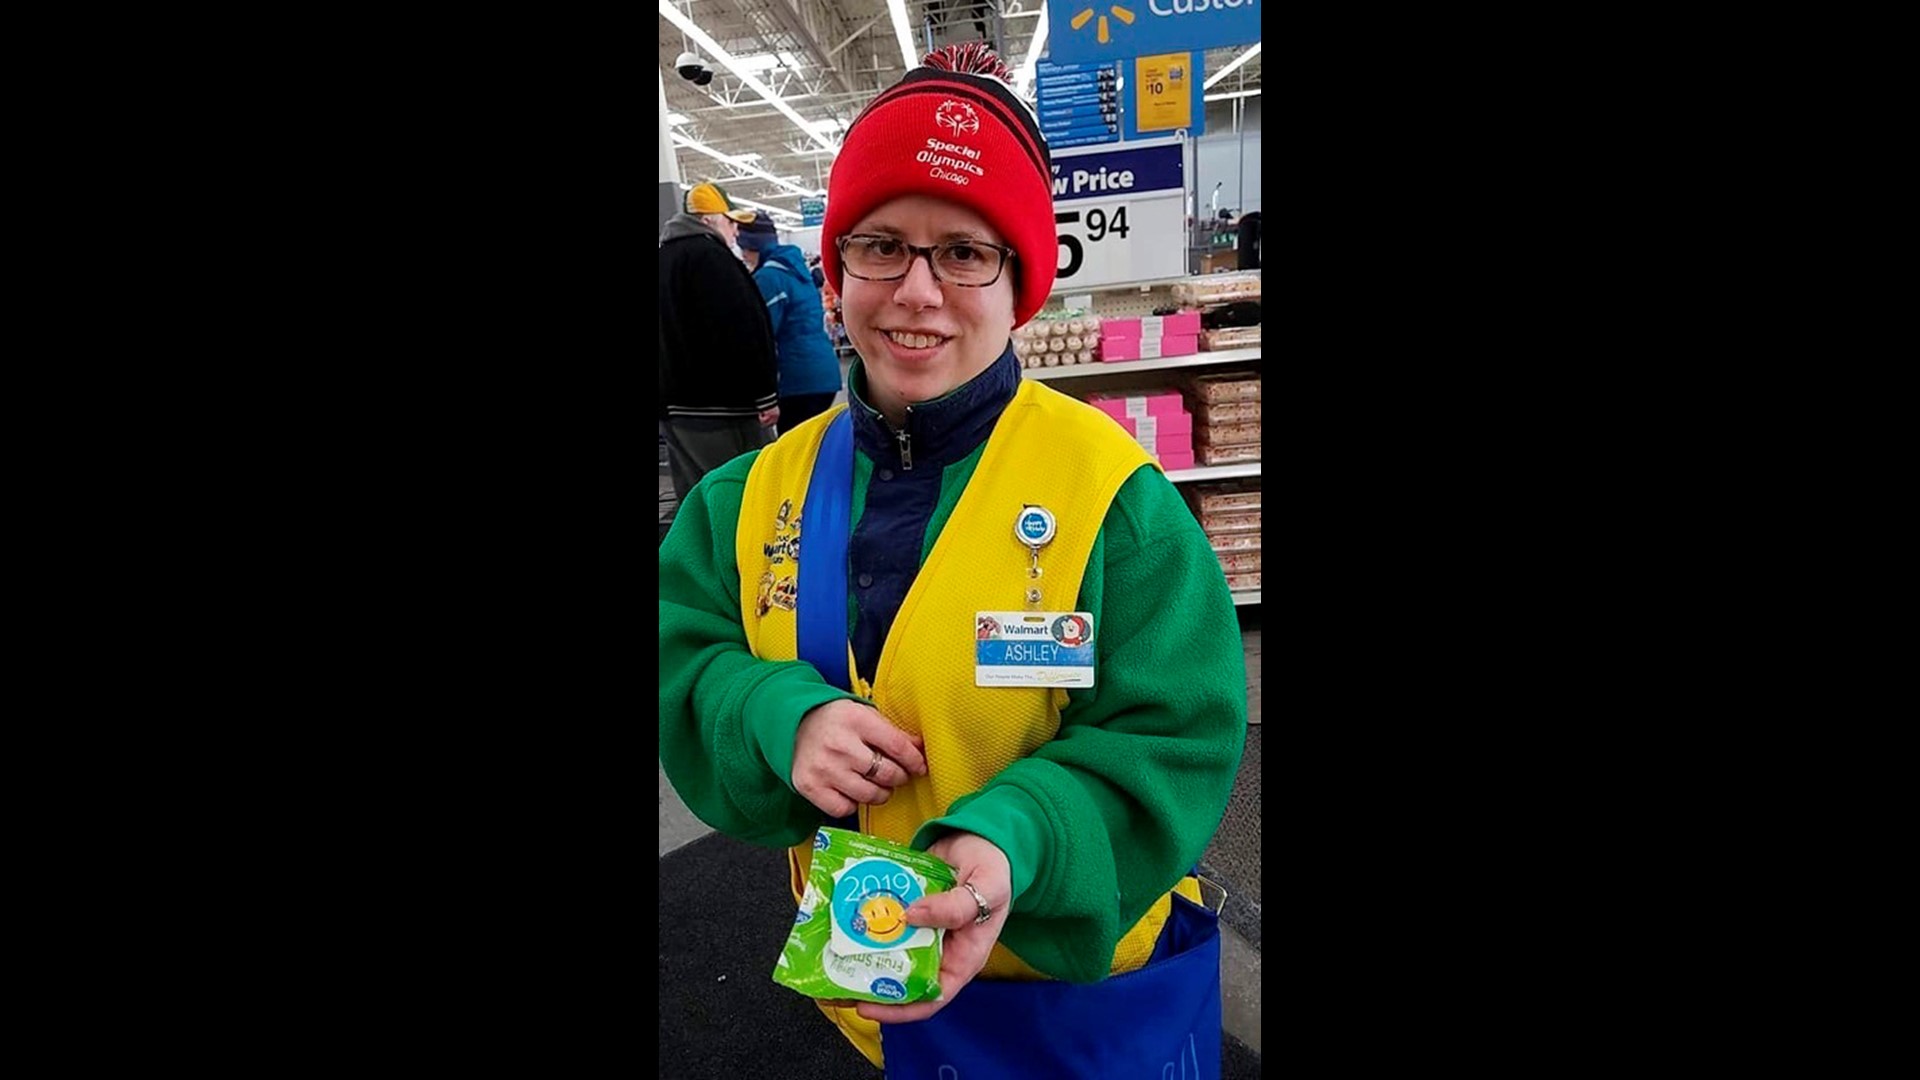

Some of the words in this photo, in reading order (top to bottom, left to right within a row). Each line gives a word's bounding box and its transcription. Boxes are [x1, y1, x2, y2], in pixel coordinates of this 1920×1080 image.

[926, 138, 981, 160] Special
[916, 150, 984, 176] Olympics
[929, 166, 969, 185] Chicago
[1073, 167, 1134, 193] Price
[1004, 624, 1049, 635] Walmart
[1004, 644, 1060, 661] ASHLEY
[844, 872, 911, 902] 2019
[875, 956, 904, 973] Fruit
